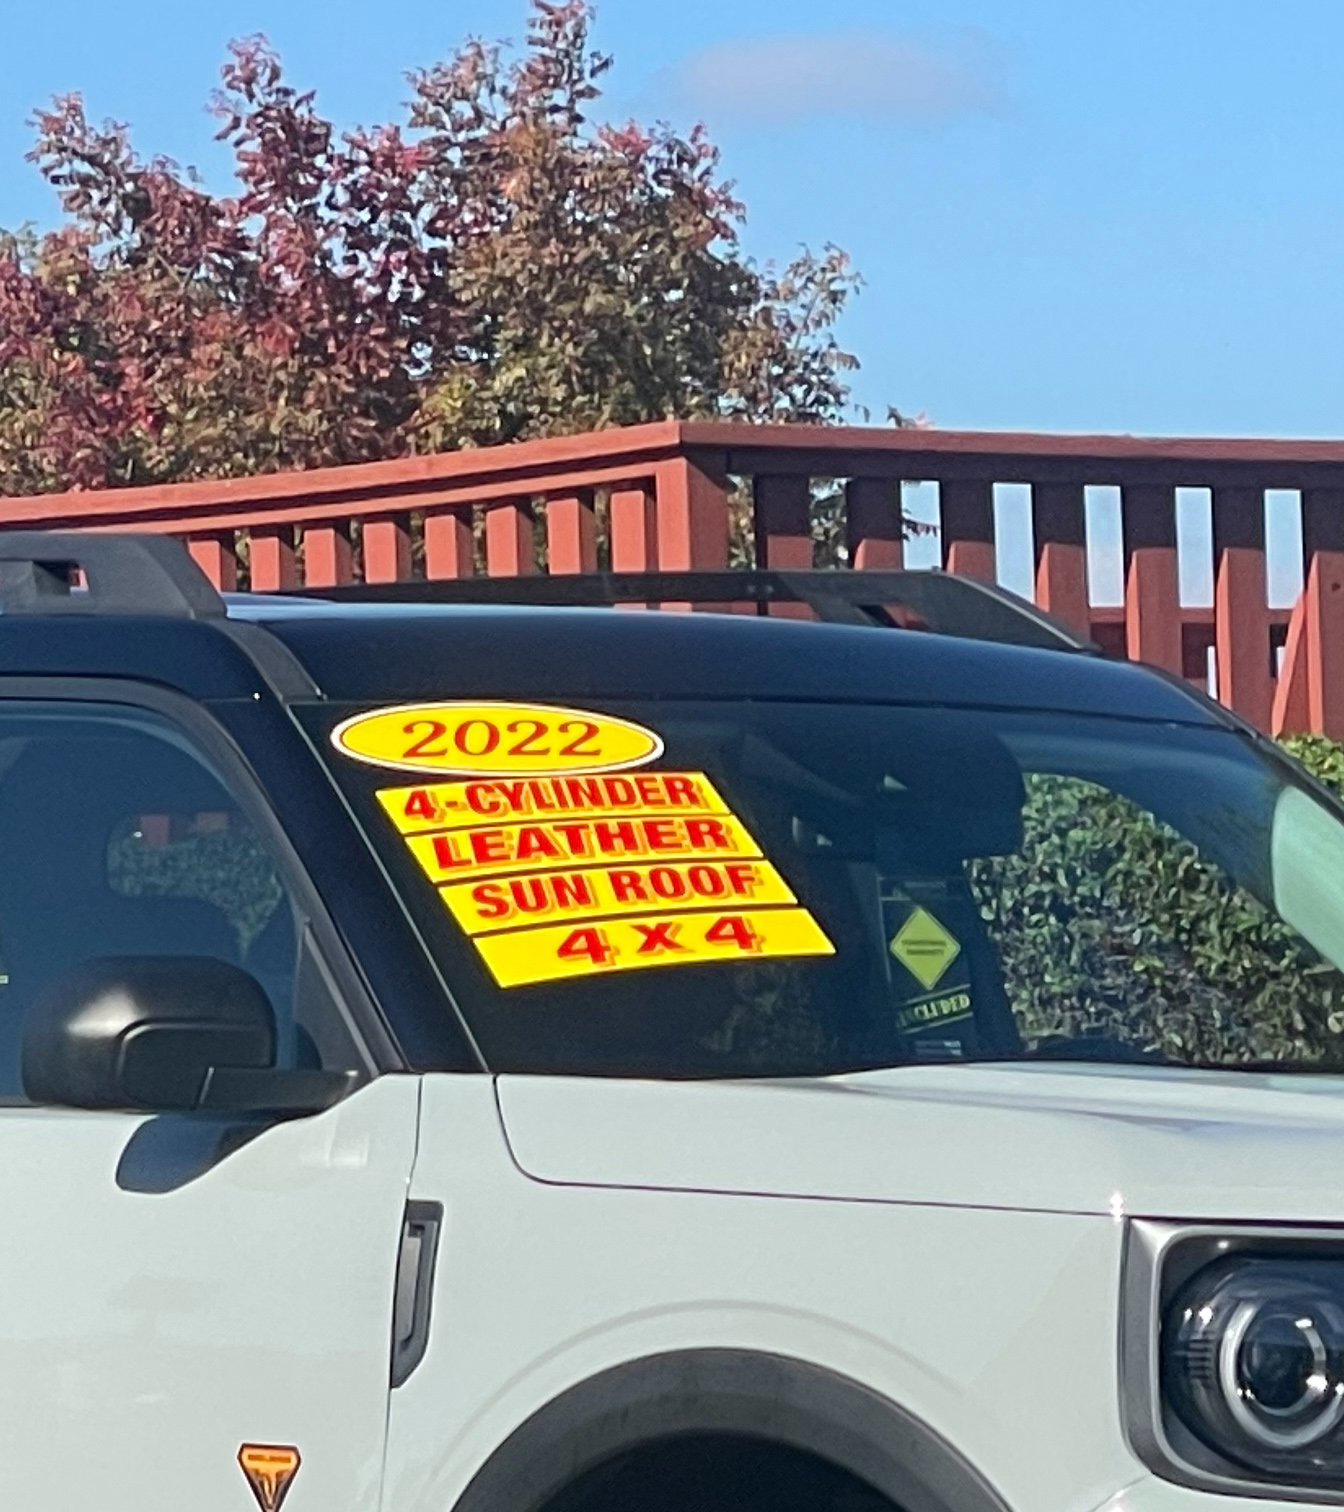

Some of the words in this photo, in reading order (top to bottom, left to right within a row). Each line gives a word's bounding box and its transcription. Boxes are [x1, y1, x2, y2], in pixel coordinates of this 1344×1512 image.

[402, 719, 603, 759] 2022
[404, 775, 703, 822] 4-CYLINDER
[433, 817, 732, 870] LEATHER
[471, 873, 593, 921] SUN
[613, 863, 763, 904] ROOF
